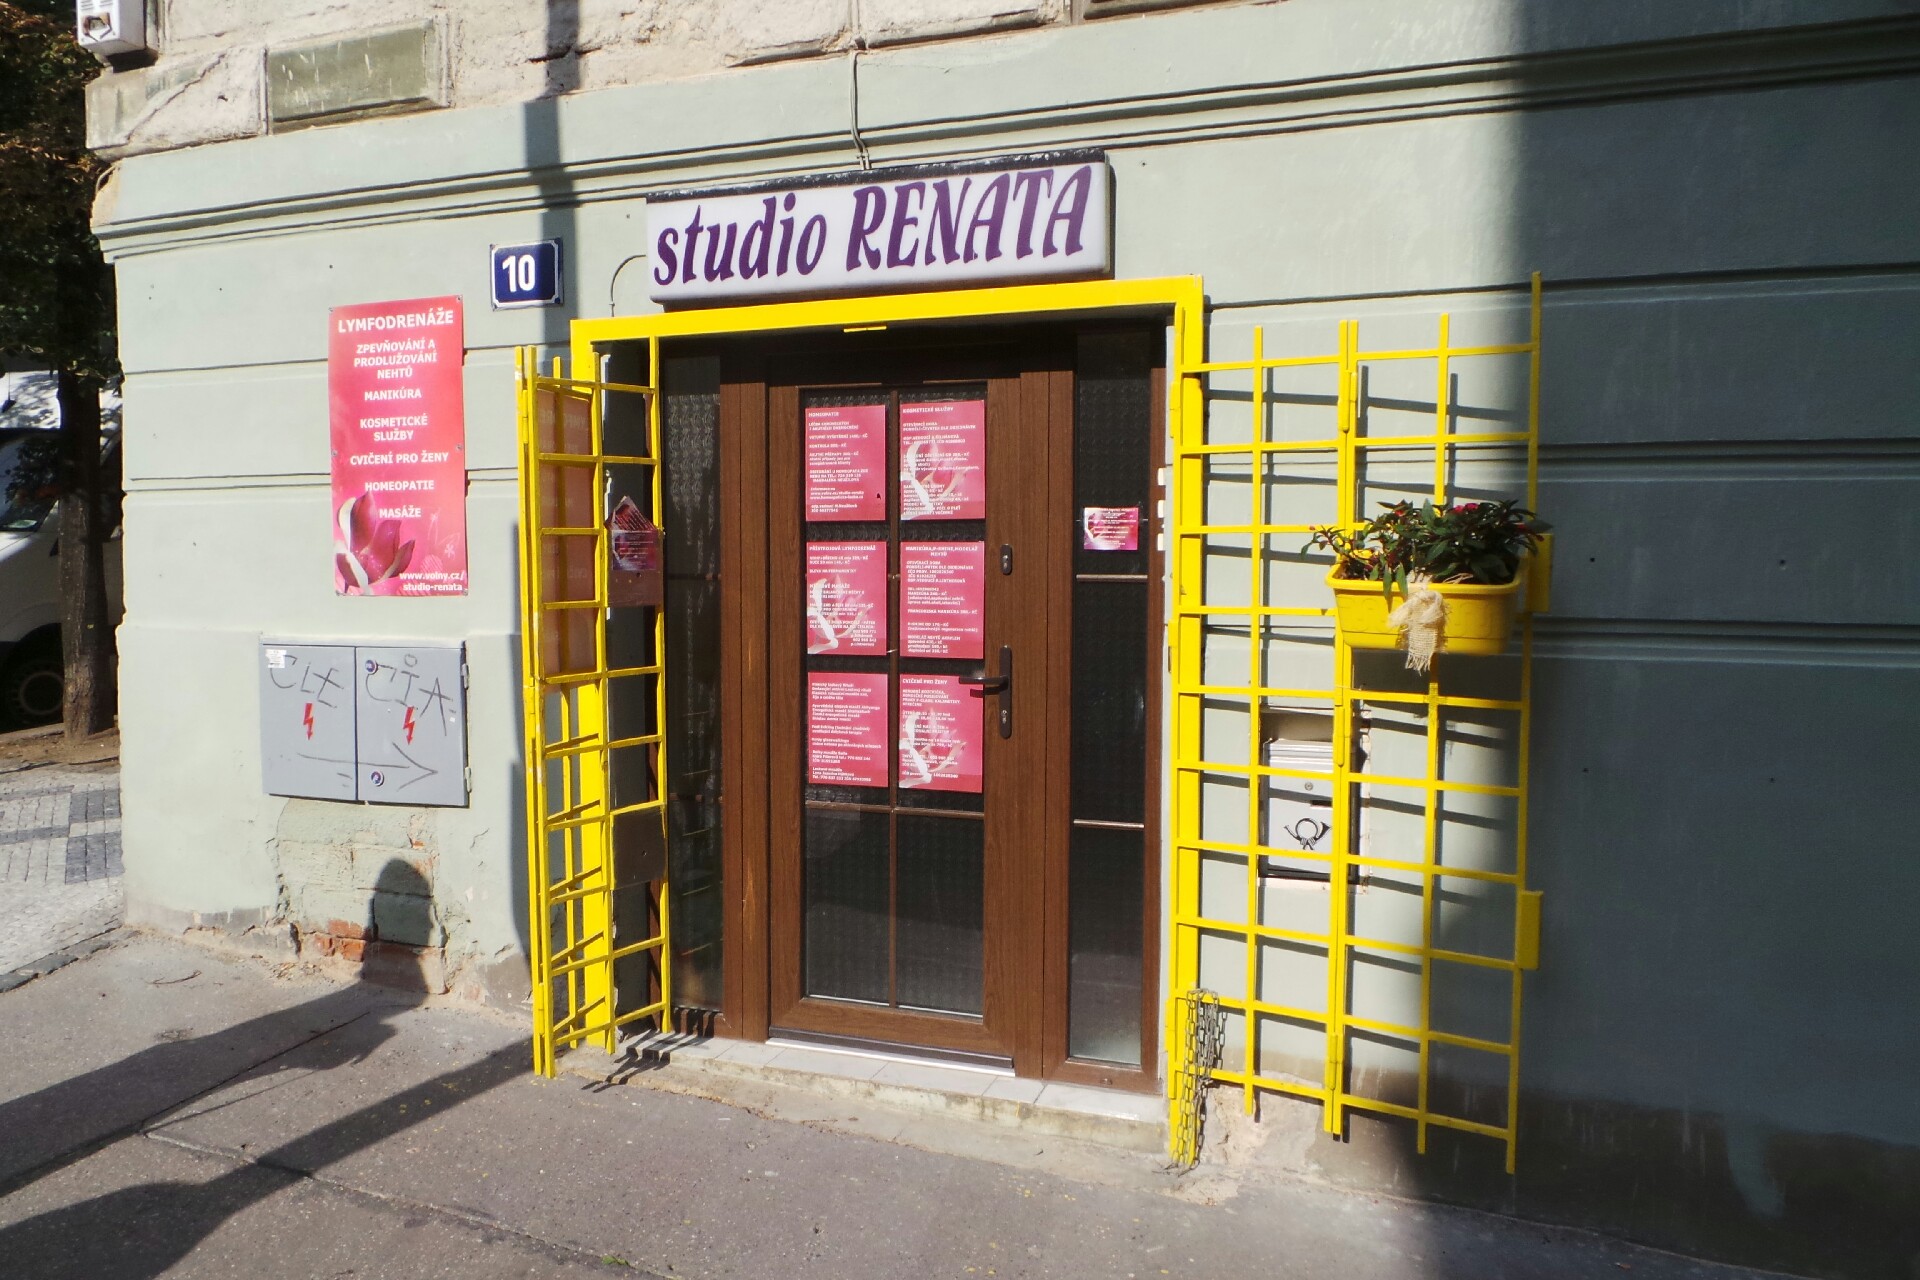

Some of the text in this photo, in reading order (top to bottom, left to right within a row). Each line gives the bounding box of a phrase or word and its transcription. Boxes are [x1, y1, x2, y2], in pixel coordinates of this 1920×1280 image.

[654, 164, 1093, 285] studio RENATA
[502, 254, 535, 293] 10
[338, 307, 454, 333] LYMFODRENÁŽE
[356, 337, 435, 354] ZPEVŇOVÁNÍ A
[354, 350, 437, 367] PRODLUŽOVÁNÍ
[377, 367, 413, 379] NEHTŮ
[364, 386, 422, 401] MANIKÚRA
[360, 413, 428, 429] KOSMETICKÉ
[373, 428, 414, 441] SLUŽBY
[350, 450, 449, 465] CVIČENÍ PRO ŽENY
[365, 480, 435, 491] HOMEOPATIE
[380, 505, 421, 518] MASÁŽE
[400, 570, 465, 582] www.volny.cz/
[403, 583, 463, 591] studio-renata
